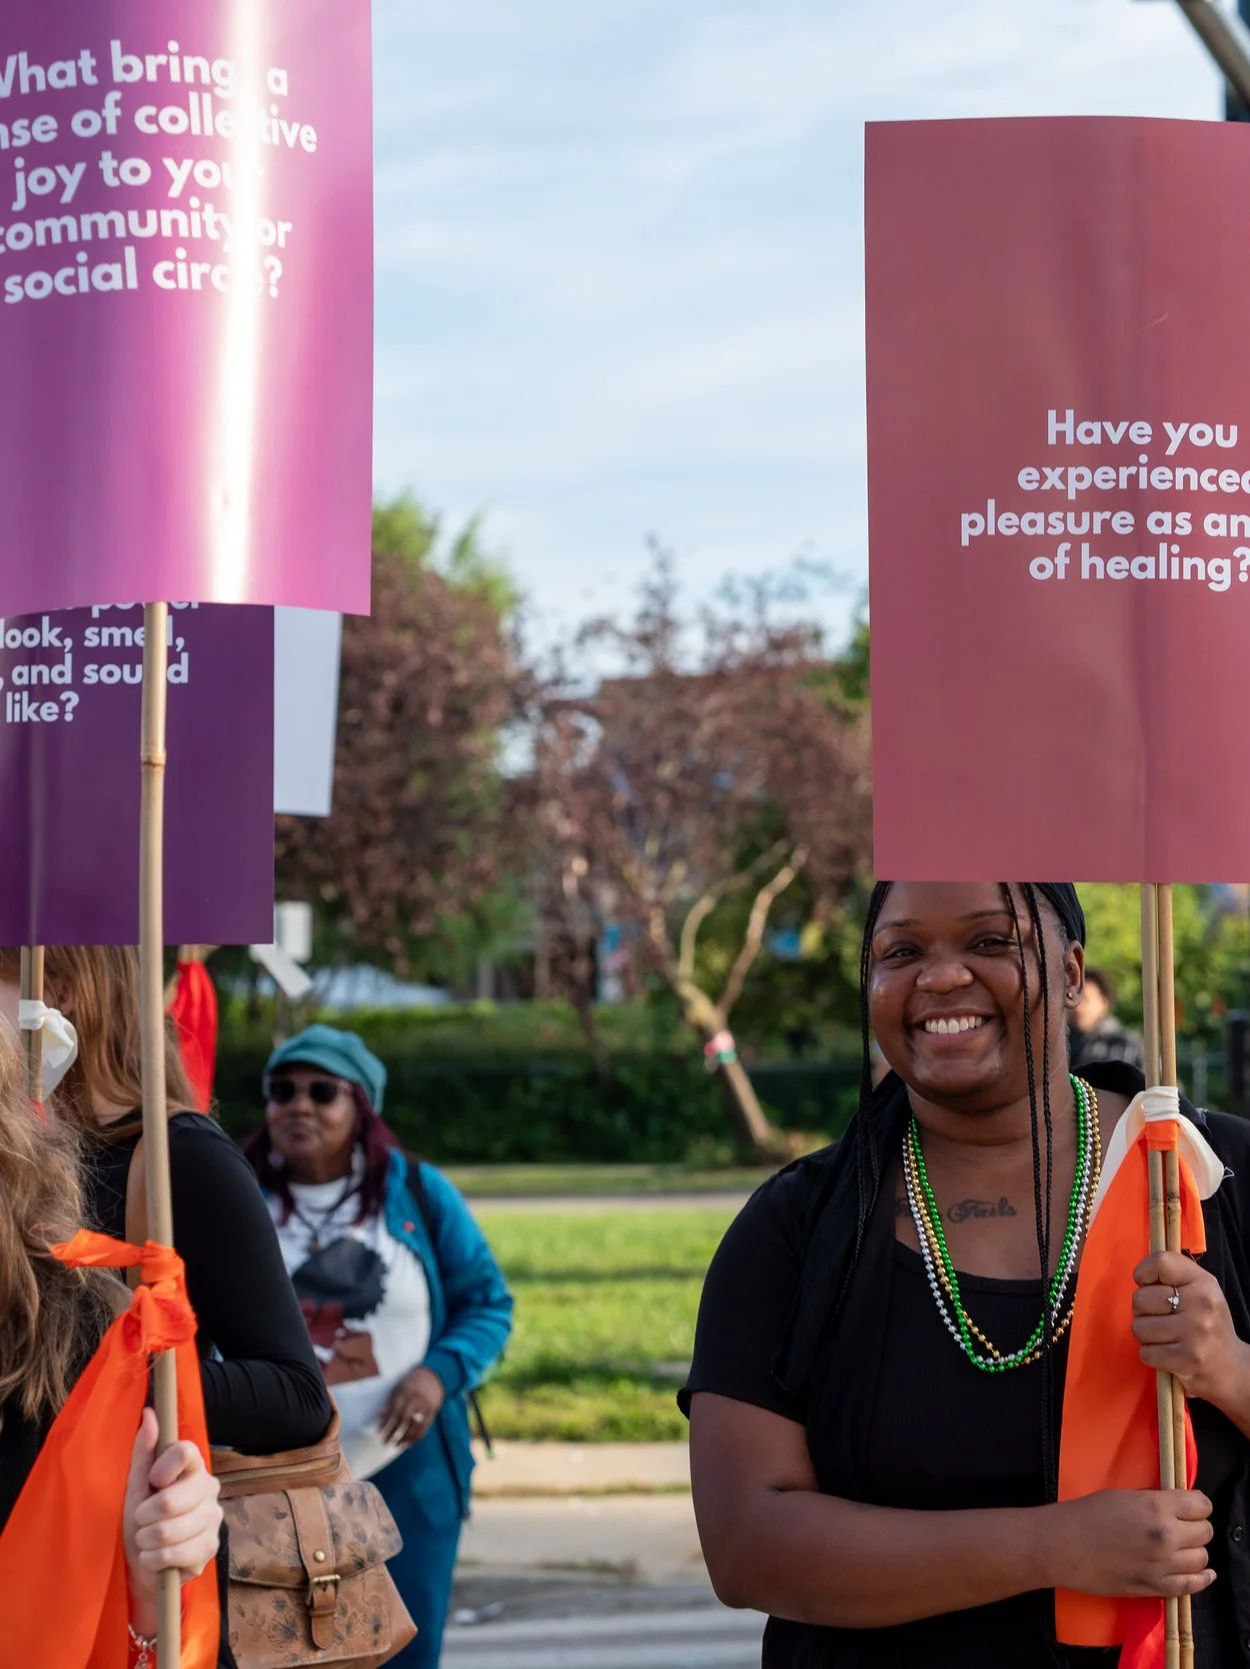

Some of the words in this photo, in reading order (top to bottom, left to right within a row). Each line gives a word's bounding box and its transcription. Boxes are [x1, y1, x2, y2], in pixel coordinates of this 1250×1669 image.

[110, 40, 246, 98] bring
[266, 66, 288, 96] a
[71, 90, 122, 138] of
[134, 92, 318, 153] colletive
[12, 157, 86, 211] joy
[99, 151, 151, 187] to
[256, 217, 293, 249] or
[4, 246, 138, 303] social
[1047, 409, 1152, 445] Have
[1163, 422, 1238, 455] you
[961, 498, 1135, 546] pleasure
[1146, 510, 1193, 535] as
[1028, 542, 1071, 580] of
[83, 615, 185, 652] smel,
[12, 653, 72, 685] and
[83, 652, 189, 685] soud
[6, 691, 80, 723] like?
